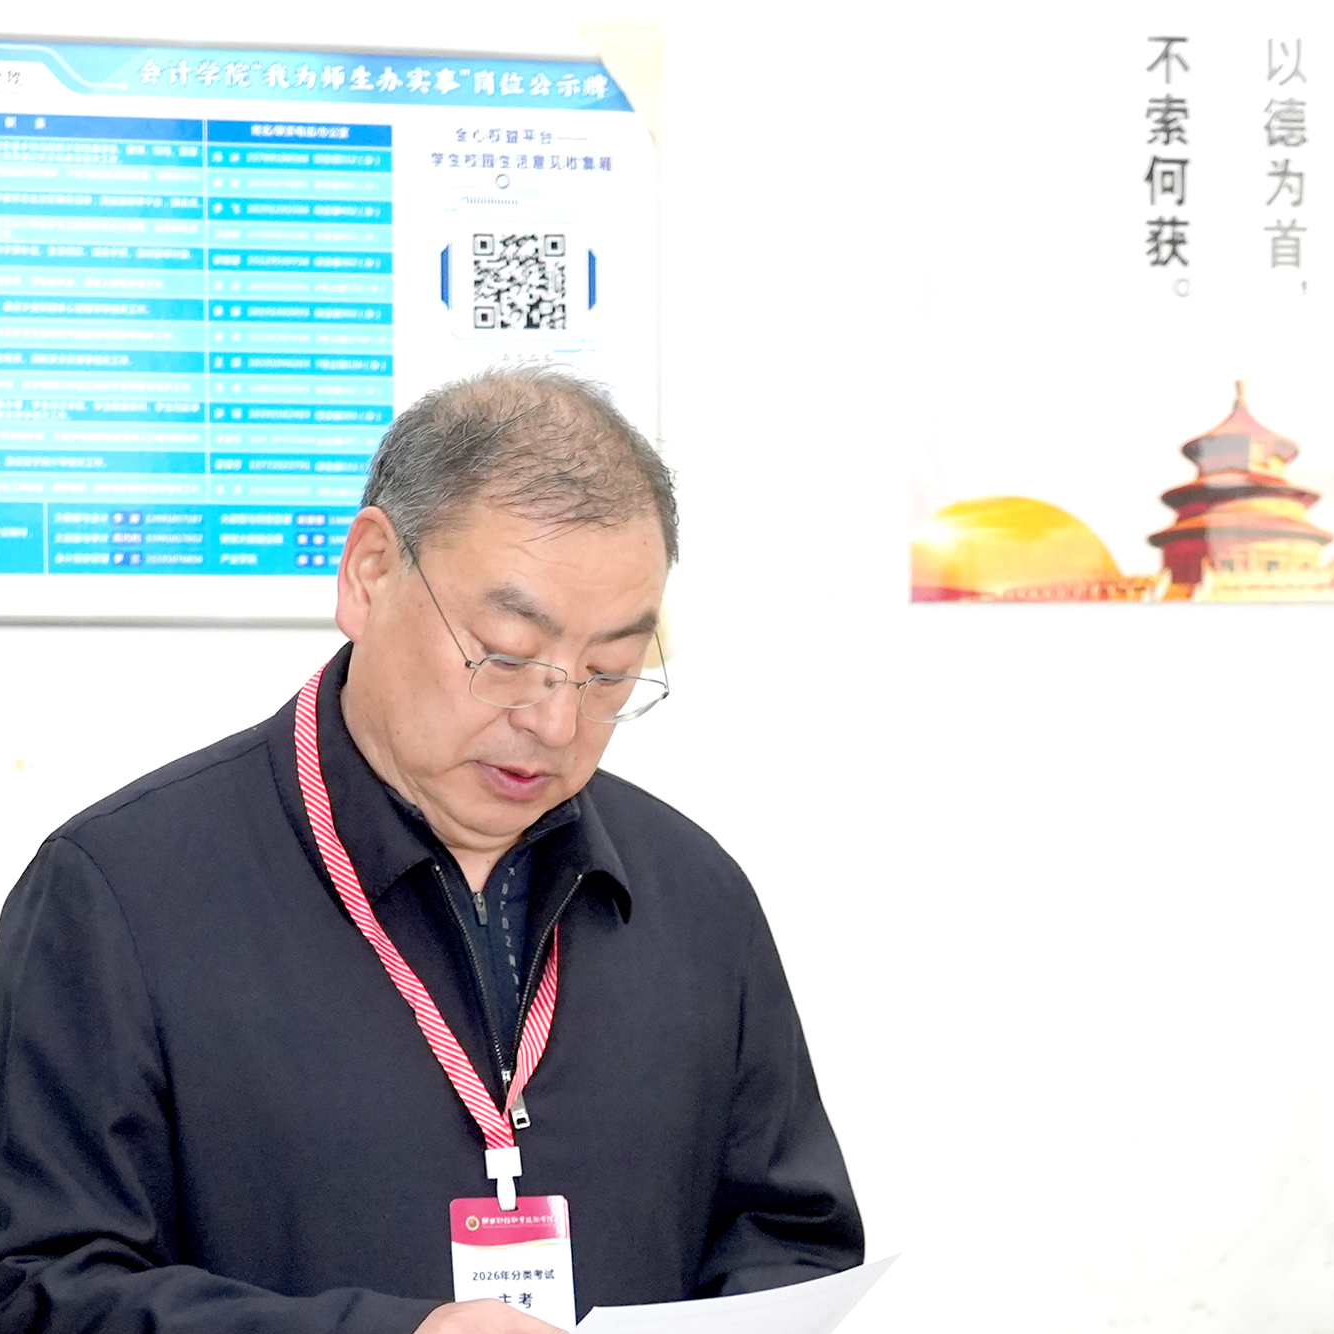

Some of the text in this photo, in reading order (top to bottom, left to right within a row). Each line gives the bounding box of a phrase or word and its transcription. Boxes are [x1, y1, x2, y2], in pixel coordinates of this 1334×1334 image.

[472, 1269, 555, 1281] 2026年分类考试
